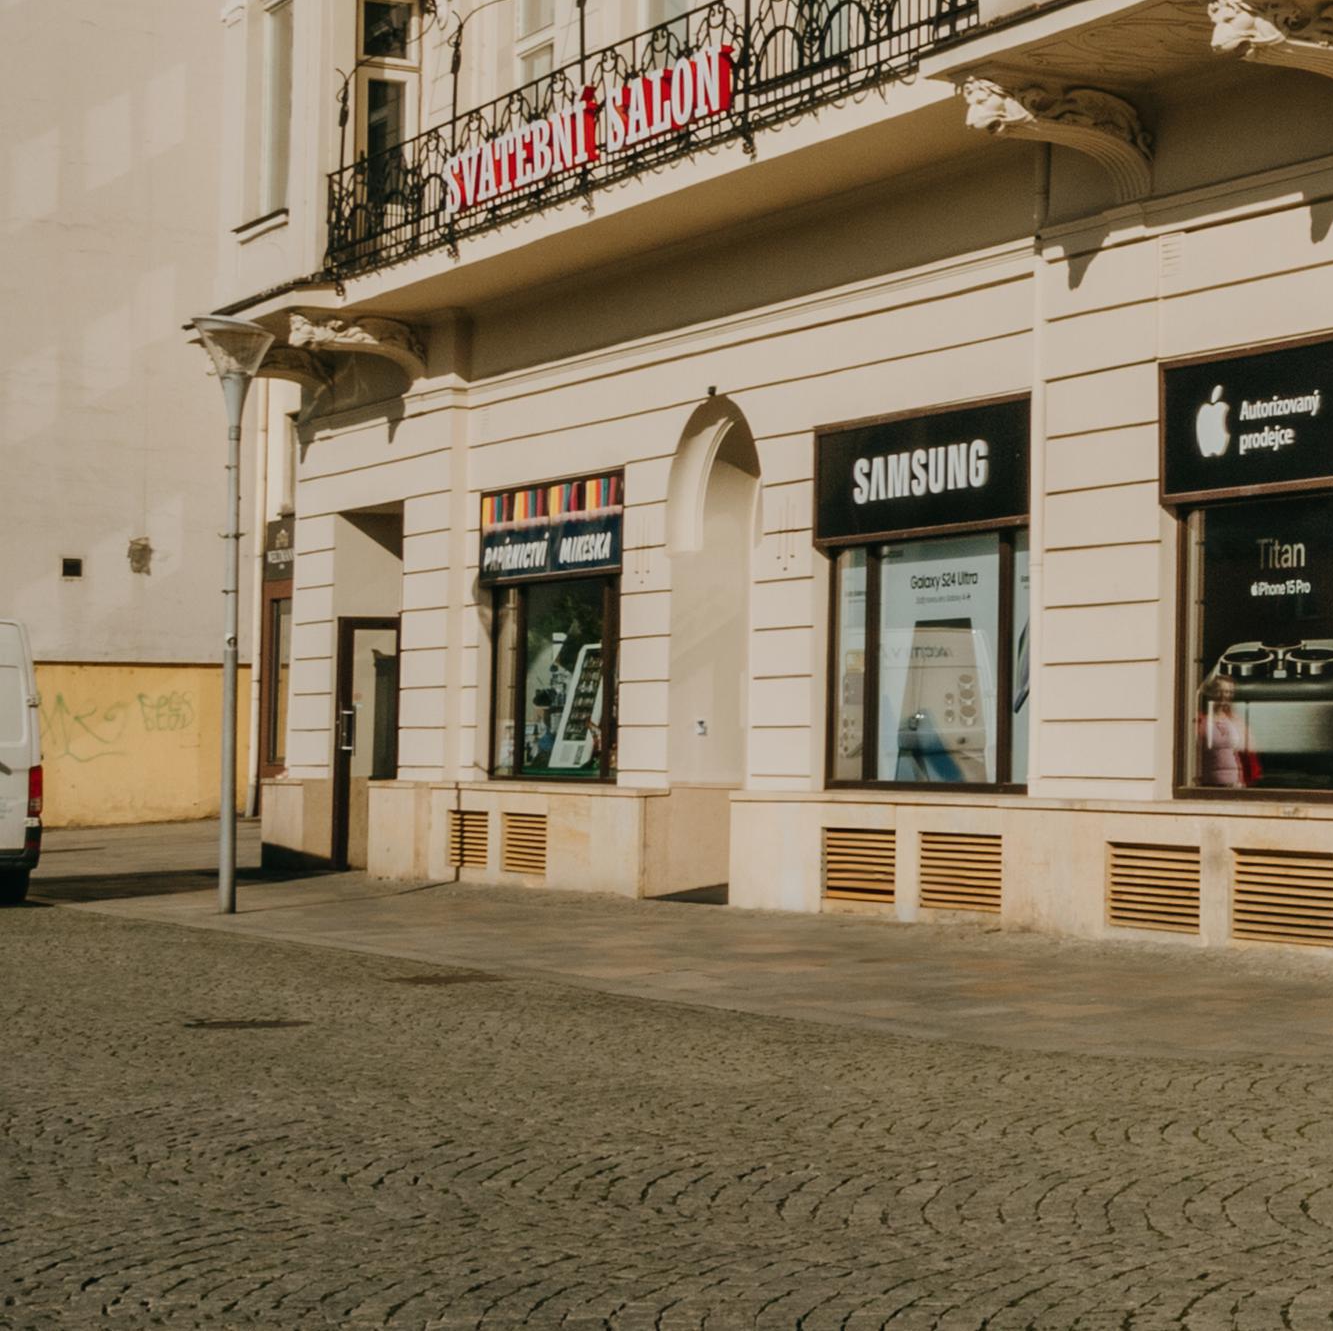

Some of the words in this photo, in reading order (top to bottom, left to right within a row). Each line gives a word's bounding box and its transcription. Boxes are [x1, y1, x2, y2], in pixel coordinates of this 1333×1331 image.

[446, 87, 589, 214] SVATEBNÍ
[606, 44, 721, 153] SALON
[1239, 389, 1321, 421] Autorizovaný
[1239, 425, 1296, 456] prodejce
[853, 439, 990, 505] SAMSUNG
[484, 532, 549, 571] PAPÍRNICTVÍ
[559, 532, 612, 564] MIKESKA
[1256, 538, 1306, 569] Titan
[911, 575, 940, 592] Galaxy
[942, 572, 956, 588] S24
[957, 572, 978, 586] Ultra
